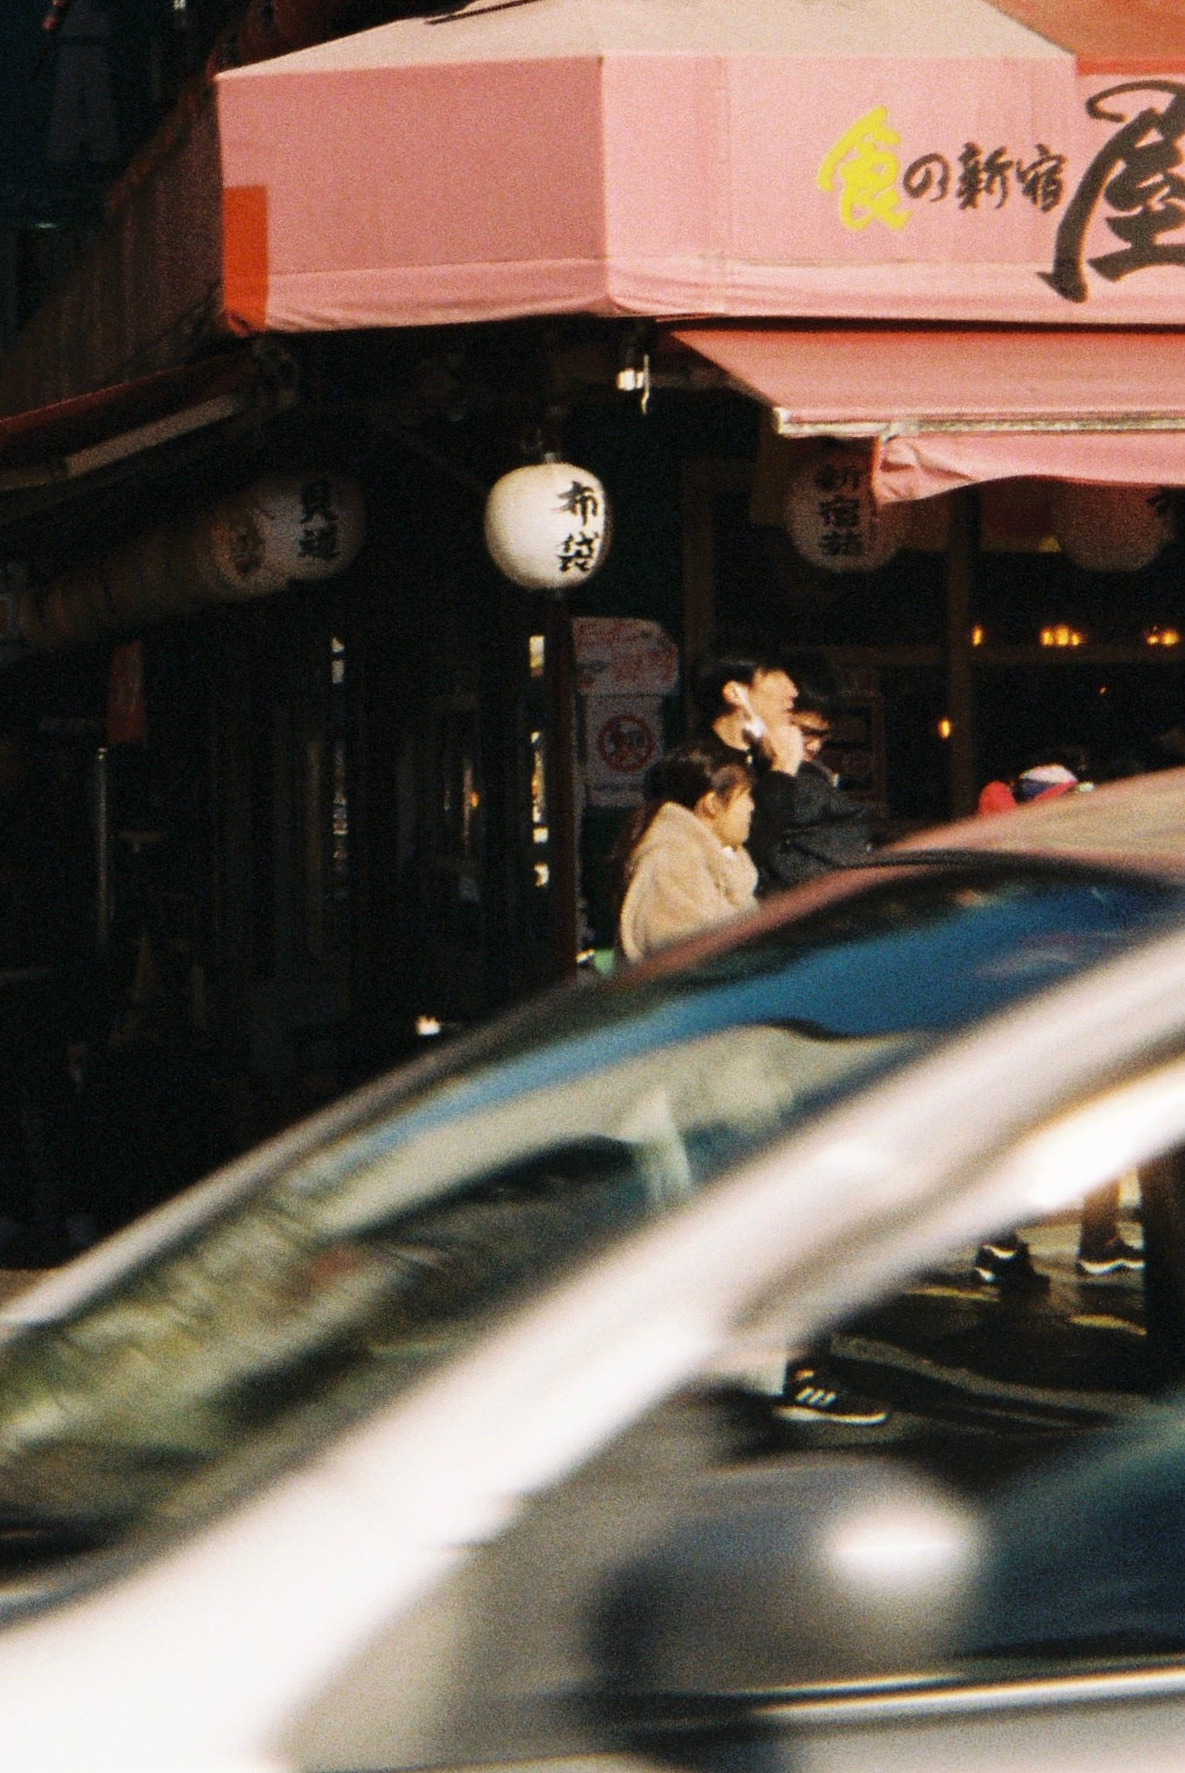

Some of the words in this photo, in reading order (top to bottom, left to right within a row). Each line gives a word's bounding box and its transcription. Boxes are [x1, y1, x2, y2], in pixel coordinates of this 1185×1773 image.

[819, 107, 1068, 231] 食の新宿
[550, 480, 600, 572] 布袋
